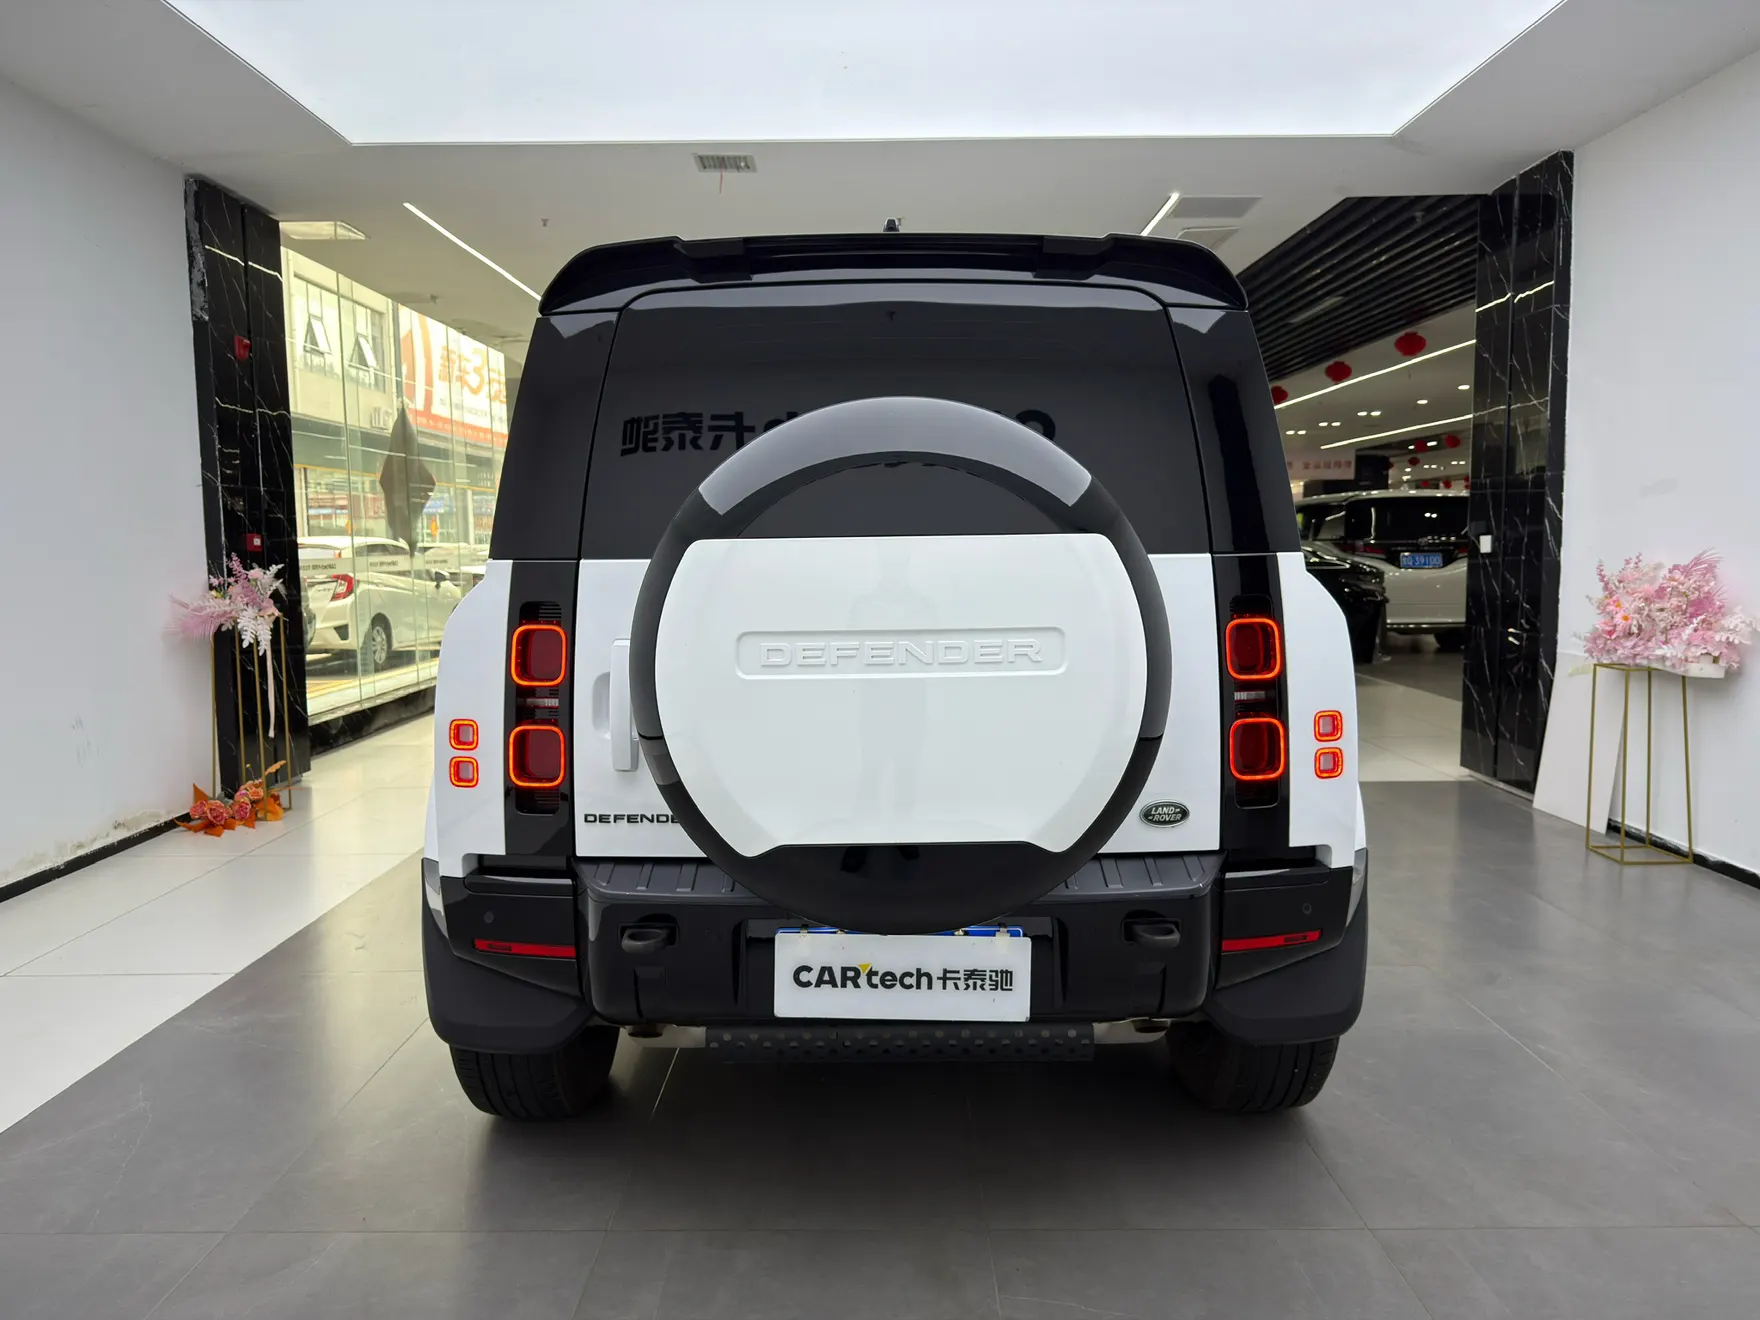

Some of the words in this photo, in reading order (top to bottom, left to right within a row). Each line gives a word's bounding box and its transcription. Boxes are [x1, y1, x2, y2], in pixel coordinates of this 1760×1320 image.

[759, 638, 1042, 666] DEFENDER
[1151, 806, 1175, 815] LAND
[1153, 813, 1182, 822] ROVER
[792, 963, 933, 991] CARtech
[936, 968, 1014, 992] 卡泰驰
